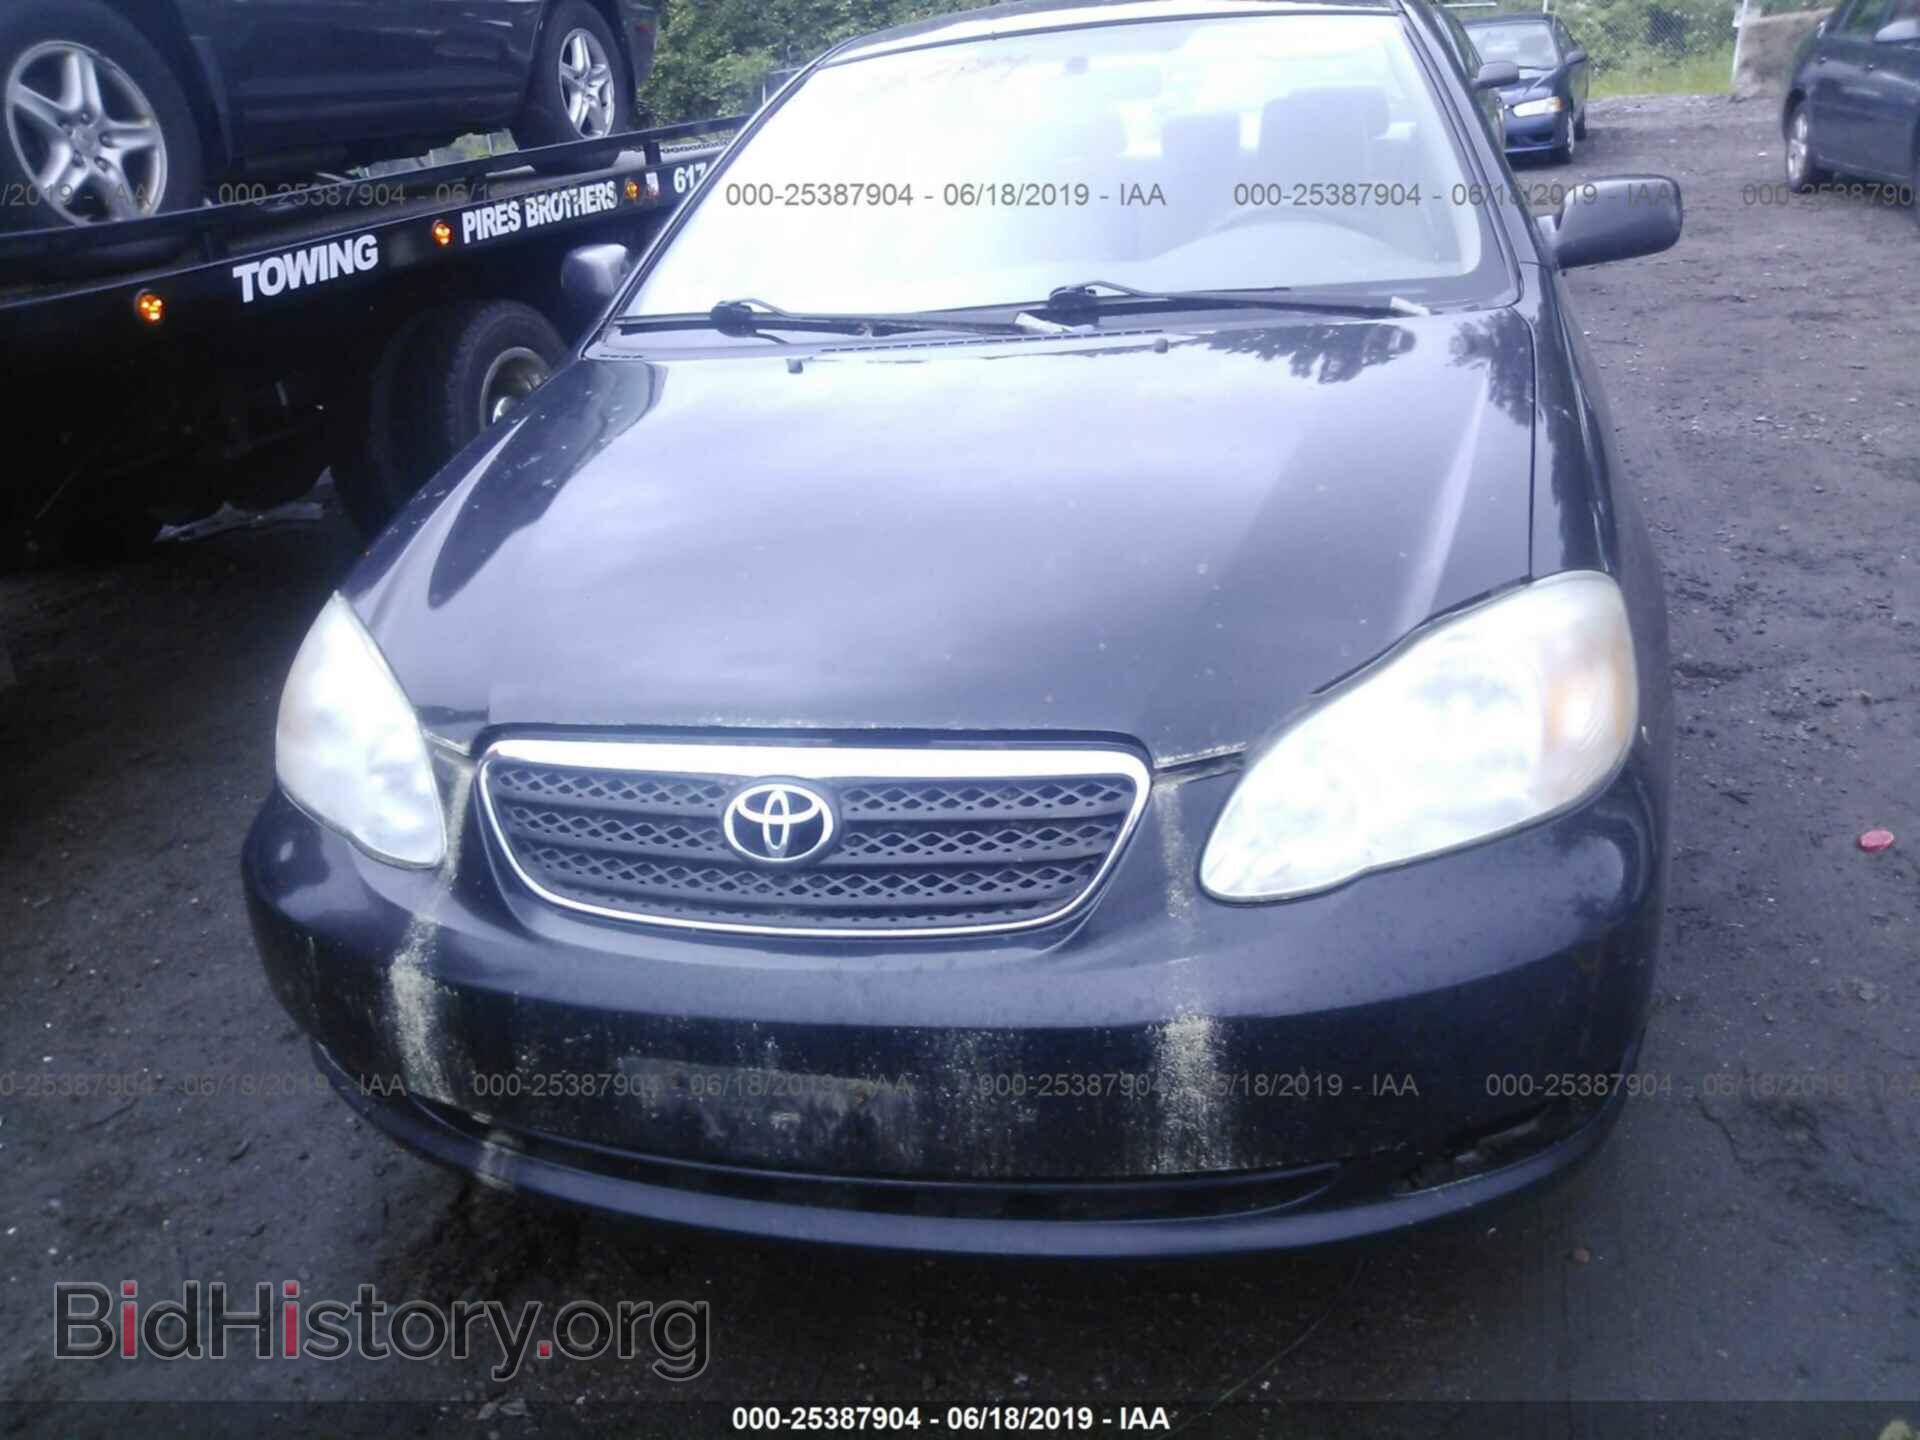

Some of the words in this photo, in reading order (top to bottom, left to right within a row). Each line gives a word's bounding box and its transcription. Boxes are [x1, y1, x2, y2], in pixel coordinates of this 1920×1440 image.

[461, 203, 521, 244] PIRES
[525, 180, 618, 229] BROTHERS
[232, 234, 379, 303] TOWING
